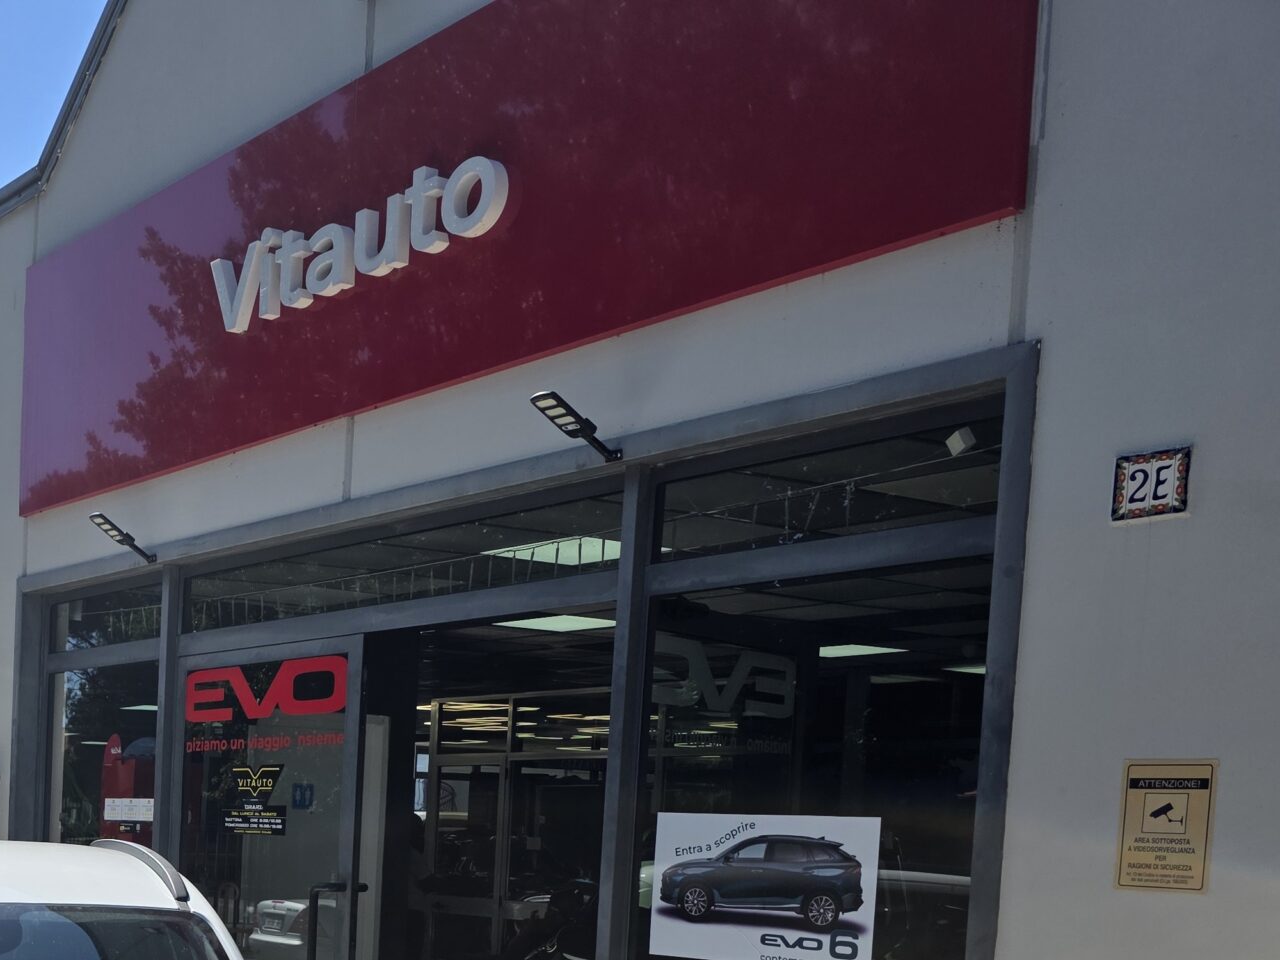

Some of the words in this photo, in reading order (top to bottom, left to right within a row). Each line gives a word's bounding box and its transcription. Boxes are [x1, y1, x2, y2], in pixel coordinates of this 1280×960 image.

[211, 156, 509, 334] Vitauto
[1128, 464, 1173, 504] 2E
[185, 655, 348, 722] EVO
[230, 738, 246, 751] un
[248, 733, 292, 752] viaggio
[238, 778, 273, 787] VITAUTO
[1138, 779, 1201, 788] ATTENZIONE!
[674, 843, 703, 858] Entra
[705, 844, 712, 853] a
[713, 820, 757, 849] scoprire
[760, 932, 824, 952] EVO
[828, 929, 859, 960] 6
